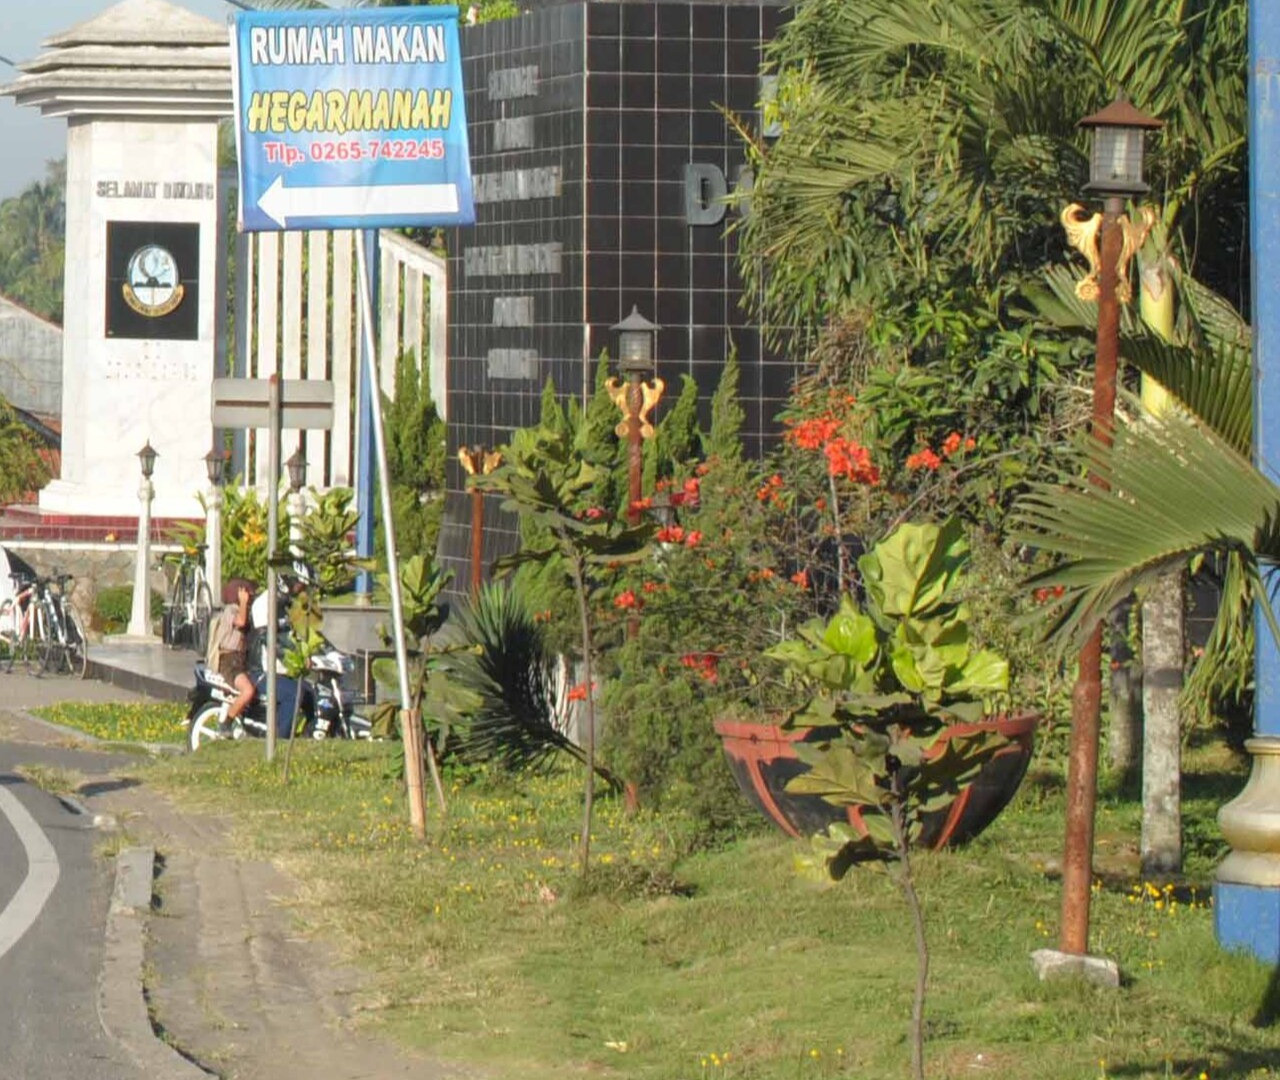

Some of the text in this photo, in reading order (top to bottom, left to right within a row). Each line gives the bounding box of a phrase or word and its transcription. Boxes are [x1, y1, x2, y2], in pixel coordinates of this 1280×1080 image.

[250, 23, 446, 65] RUMAH MAKAN
[247, 88, 453, 135] HEGARMANAH
[265, 139, 445, 166] Tlp. 0265-742245
[96, 180, 158, 199] SELAMAT
